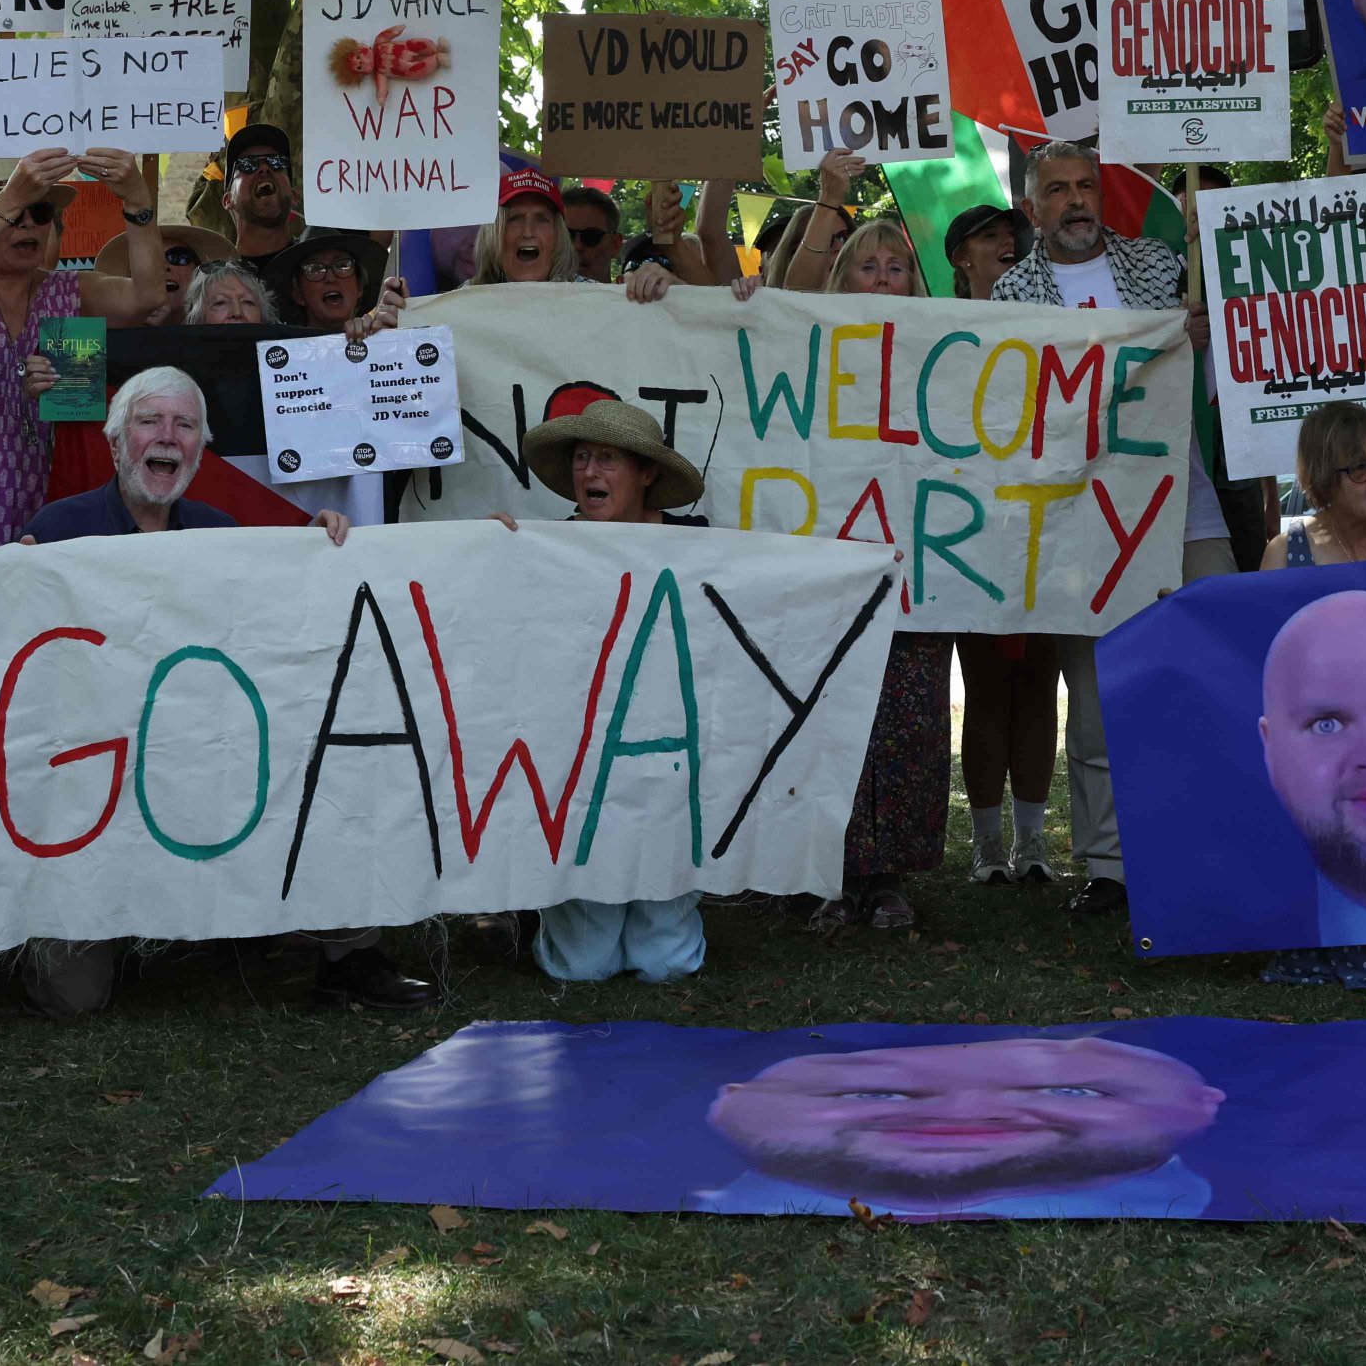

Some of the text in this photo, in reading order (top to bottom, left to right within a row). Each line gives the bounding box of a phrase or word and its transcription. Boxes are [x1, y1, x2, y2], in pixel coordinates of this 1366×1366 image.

[780, 1, 934, 33] CAT LADIES
[578, 27, 748, 76] VD WOULD
[123, 50, 188, 75] NOT
[776, 35, 892, 87] SAY GO
[1131, 99, 1257, 112] FREE PALESTINE
[131, 100, 222, 129] HERE!
[343, 86, 456, 141] WAR
[547, 101, 754, 133] BE MORE WELCOME
[798, 94, 948, 152] HOME
[1186, 127, 1203, 136] PSC
[317, 158, 470, 195] CRIMINAL
[1214, 219, 1325, 300] END
[47, 339, 101, 351] REPTILES
[268, 350, 283, 358] STOP
[347, 349, 366, 357] TRUMP
[417, 353, 437, 361] TRUMP
[267, 356, 286, 364] TRUMP
[369, 362, 403, 372] Don't
[274, 372, 308, 383] Don't
[370, 375, 440, 388] launder the
[275, 386, 324, 400] support
[371, 391, 423, 405] Image of
[738, 322, 1170, 461] WELCOME
[276, 402, 332, 415] Genocide
[372, 409, 430, 421] JD Vance
[1255, 407, 1298, 421] FREE
[432, 445, 451, 453] TRUMP
[434, 441, 449, 449] STOP
[355, 452, 374, 460] TRUMP
[280, 567, 894, 901] AWAY
